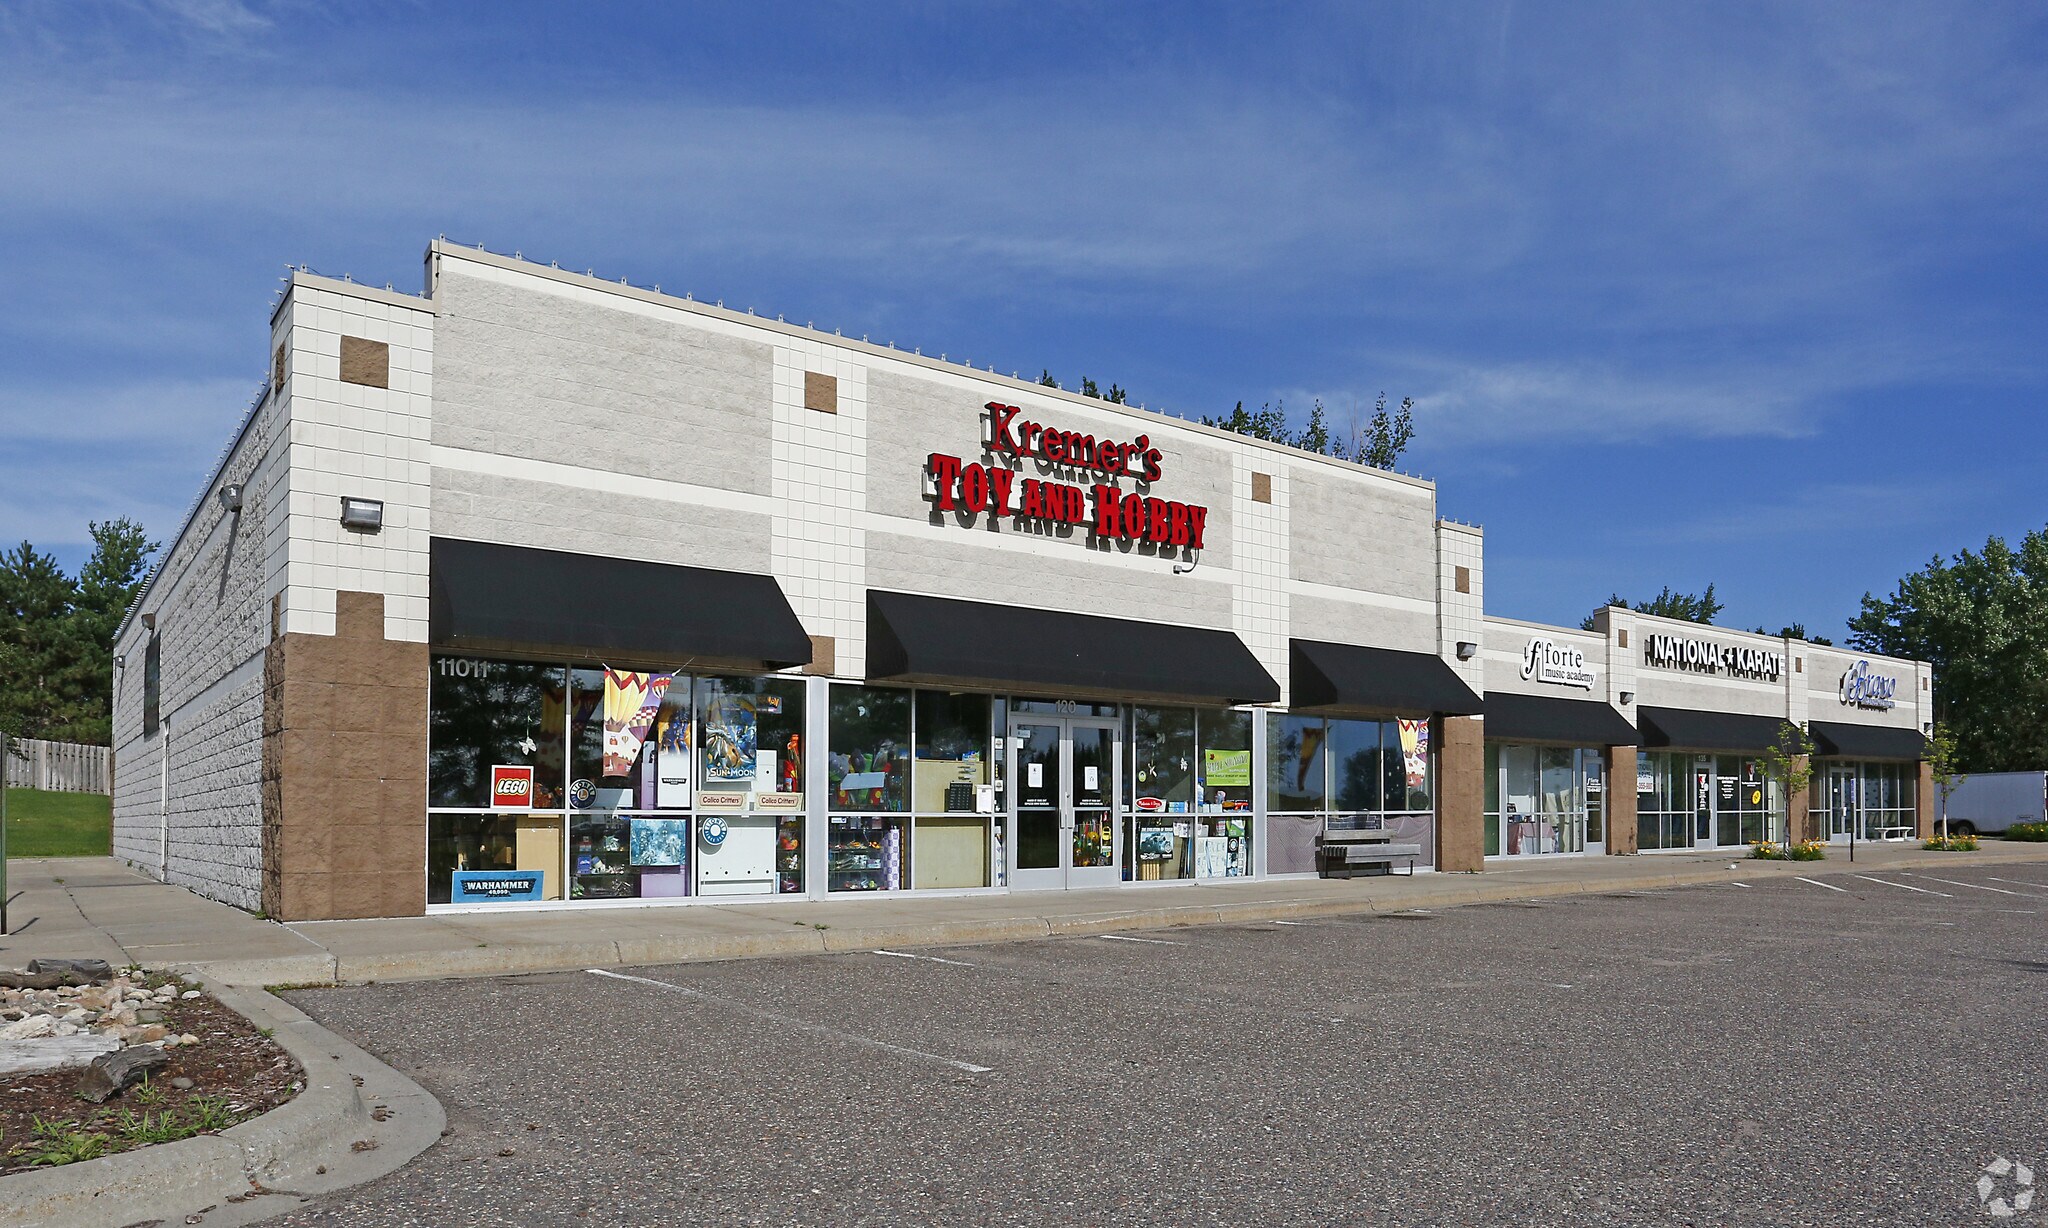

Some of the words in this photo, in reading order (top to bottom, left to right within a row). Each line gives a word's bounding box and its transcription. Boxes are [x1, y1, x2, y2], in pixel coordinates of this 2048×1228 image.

[984, 401, 1163, 482] Kremer's
[928, 453, 1015, 517] TOY
[1021, 478, 1085, 523] AND
[1092, 484, 1208, 549] HOBBY
[1545, 642, 1582, 668] forte
[1651, 634, 1727, 668] NATIONAL
[1735, 647, 1787, 676] KARATE
[437, 657, 489, 678] 11011
[1545, 668, 1566, 679] music
[1566, 669, 1595, 686] academy
[1055, 700, 1077, 714] 120
[495, 778, 530, 796] LEGO
[702, 796, 720, 804] Calico
[720, 796, 740, 804] Critters
[780, 797, 796, 805] Critters
[466, 880, 529, 891] WARHAMMER
